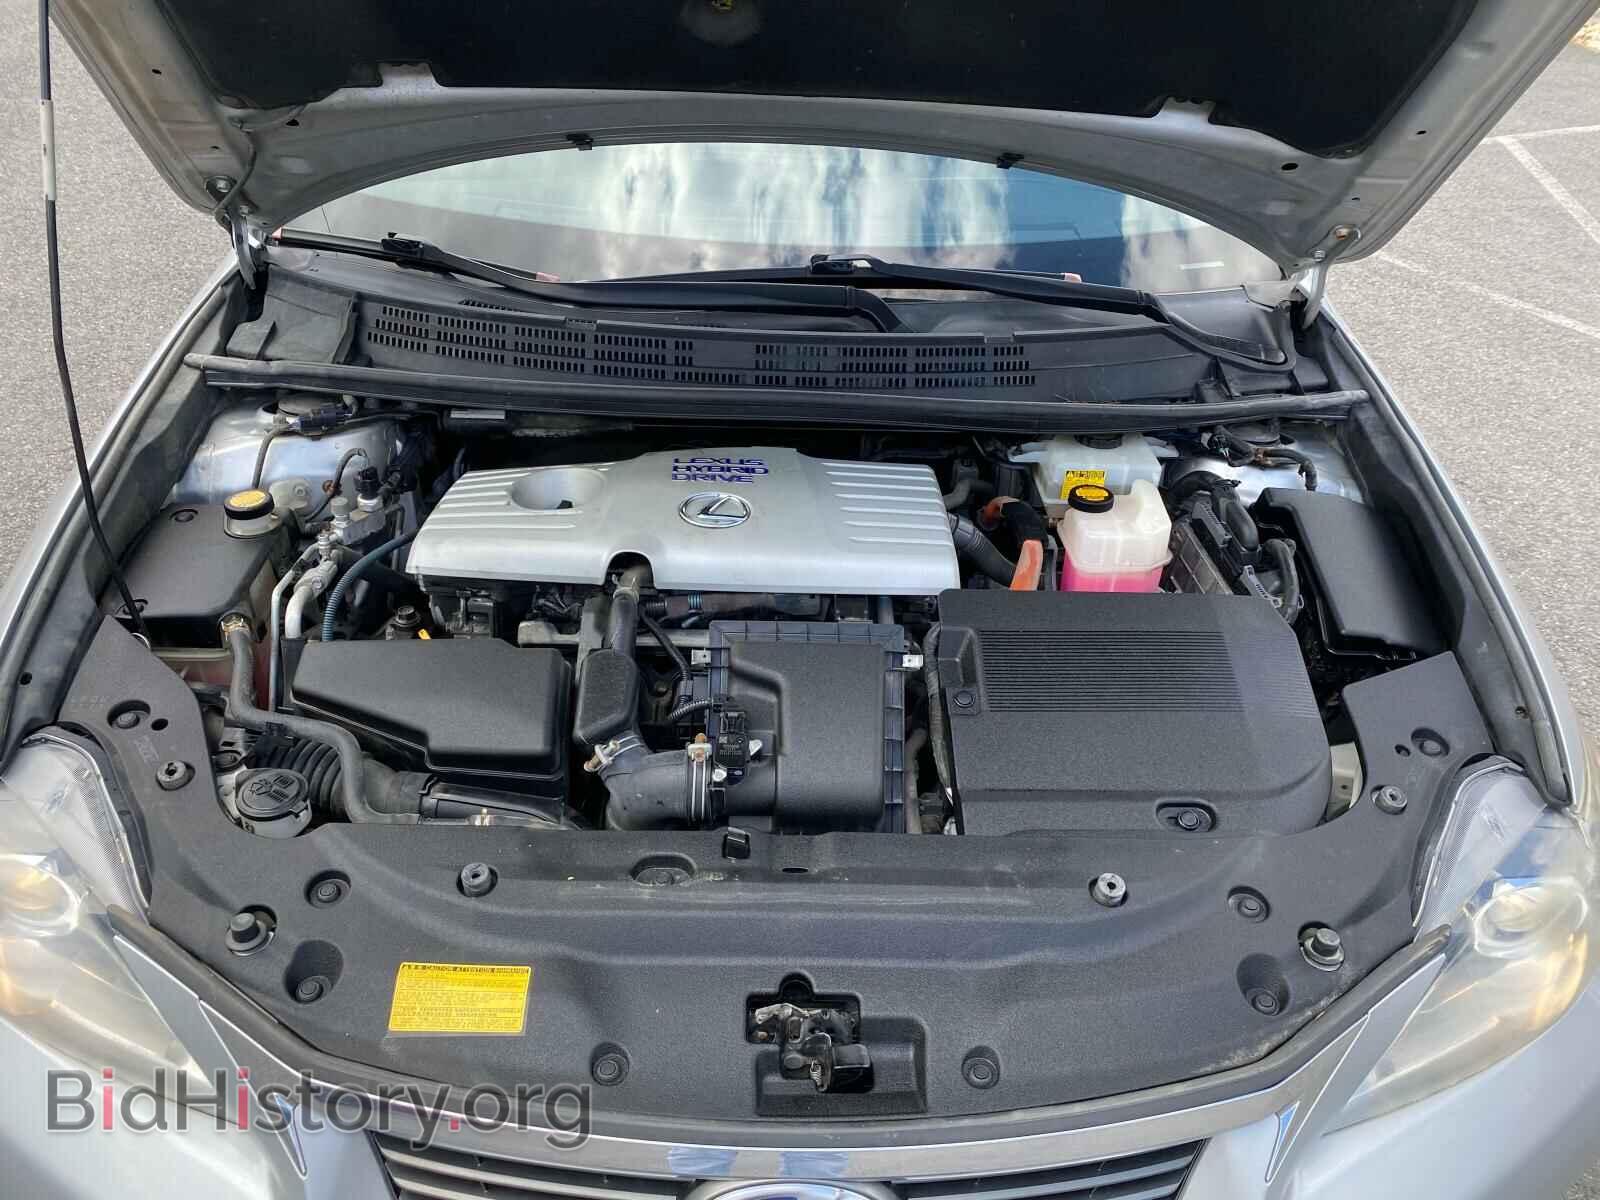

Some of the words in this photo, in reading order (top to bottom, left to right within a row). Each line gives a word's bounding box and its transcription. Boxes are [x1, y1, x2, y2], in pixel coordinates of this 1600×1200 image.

[673, 457, 764, 465] LEXUS
[672, 465, 769, 474] HYBRID
[672, 473, 753, 482] DRIVE
